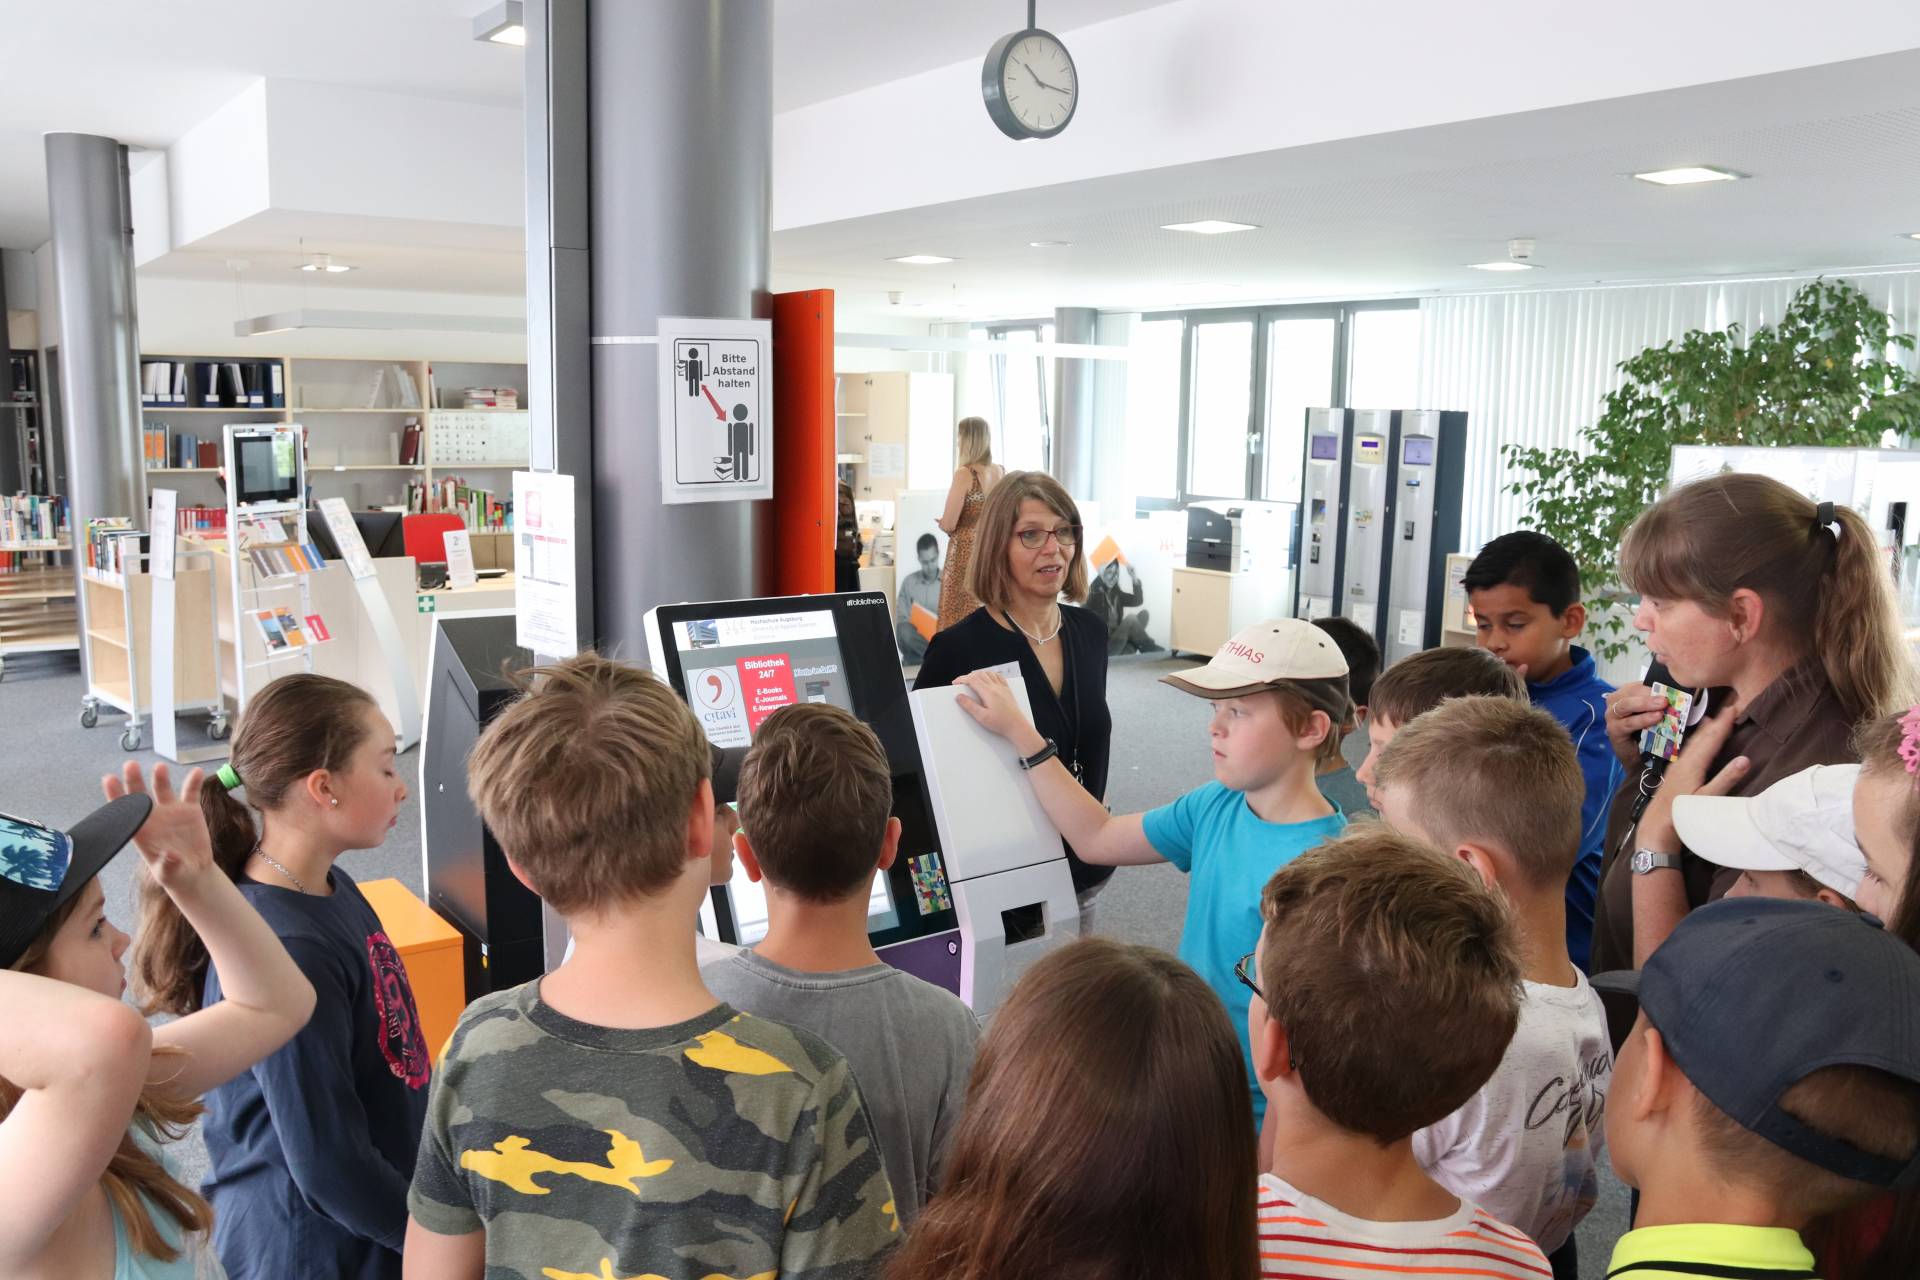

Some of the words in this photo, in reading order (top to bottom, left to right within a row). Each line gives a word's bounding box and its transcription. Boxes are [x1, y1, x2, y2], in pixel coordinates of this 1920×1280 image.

[721, 354, 747, 363] Bitte
[712, 366, 755, 376] Abstand
[718, 379, 751, 388] halten
[1224, 640, 1265, 664] THIAS
[744, 658, 785, 670] Bibliothek
[758, 669, 775, 679] 24/7
[756, 687, 783, 695] E-Books
[755, 695, 788, 704] E-Journals
